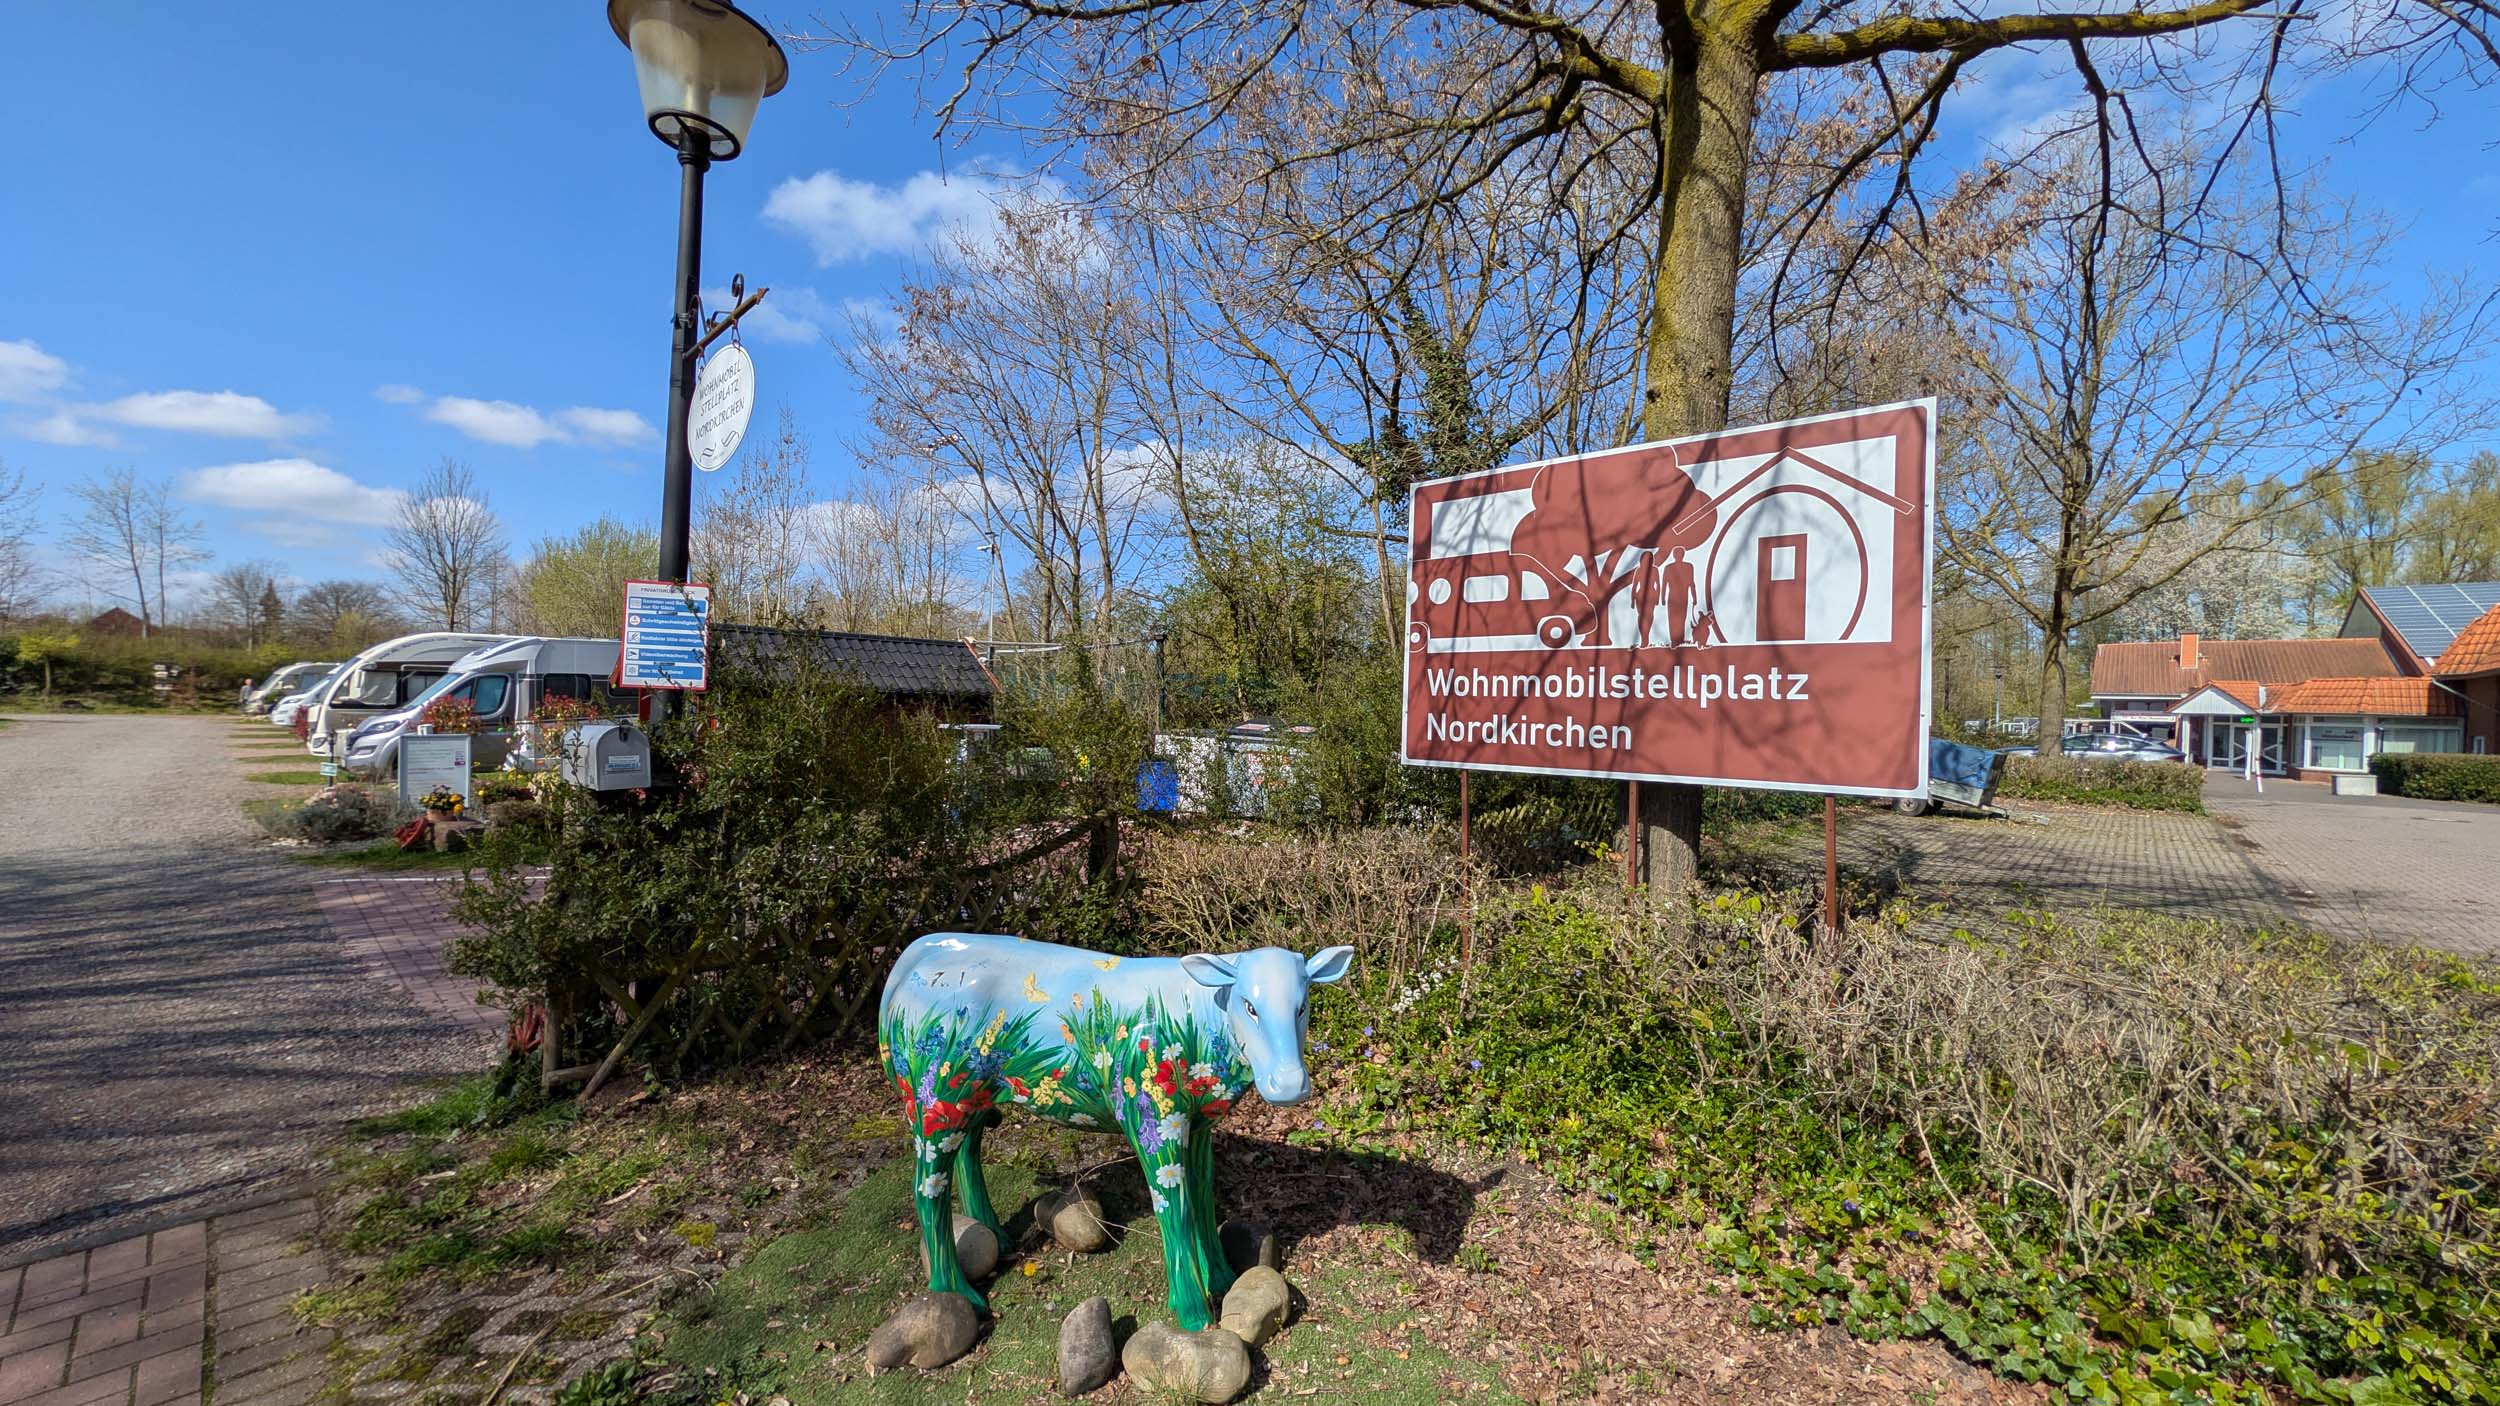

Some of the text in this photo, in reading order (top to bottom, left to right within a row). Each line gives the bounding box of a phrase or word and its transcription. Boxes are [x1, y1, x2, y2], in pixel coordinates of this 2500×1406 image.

[699, 360, 742, 400] WOHNMOBIL
[700, 379, 740, 417] STELLPLATZ
[695, 397, 745, 441] NORDKIRCHEN
[1426, 664, 1810, 709] Wohnmobilstellplatz
[1426, 712, 1633, 751] Nordkirchen
